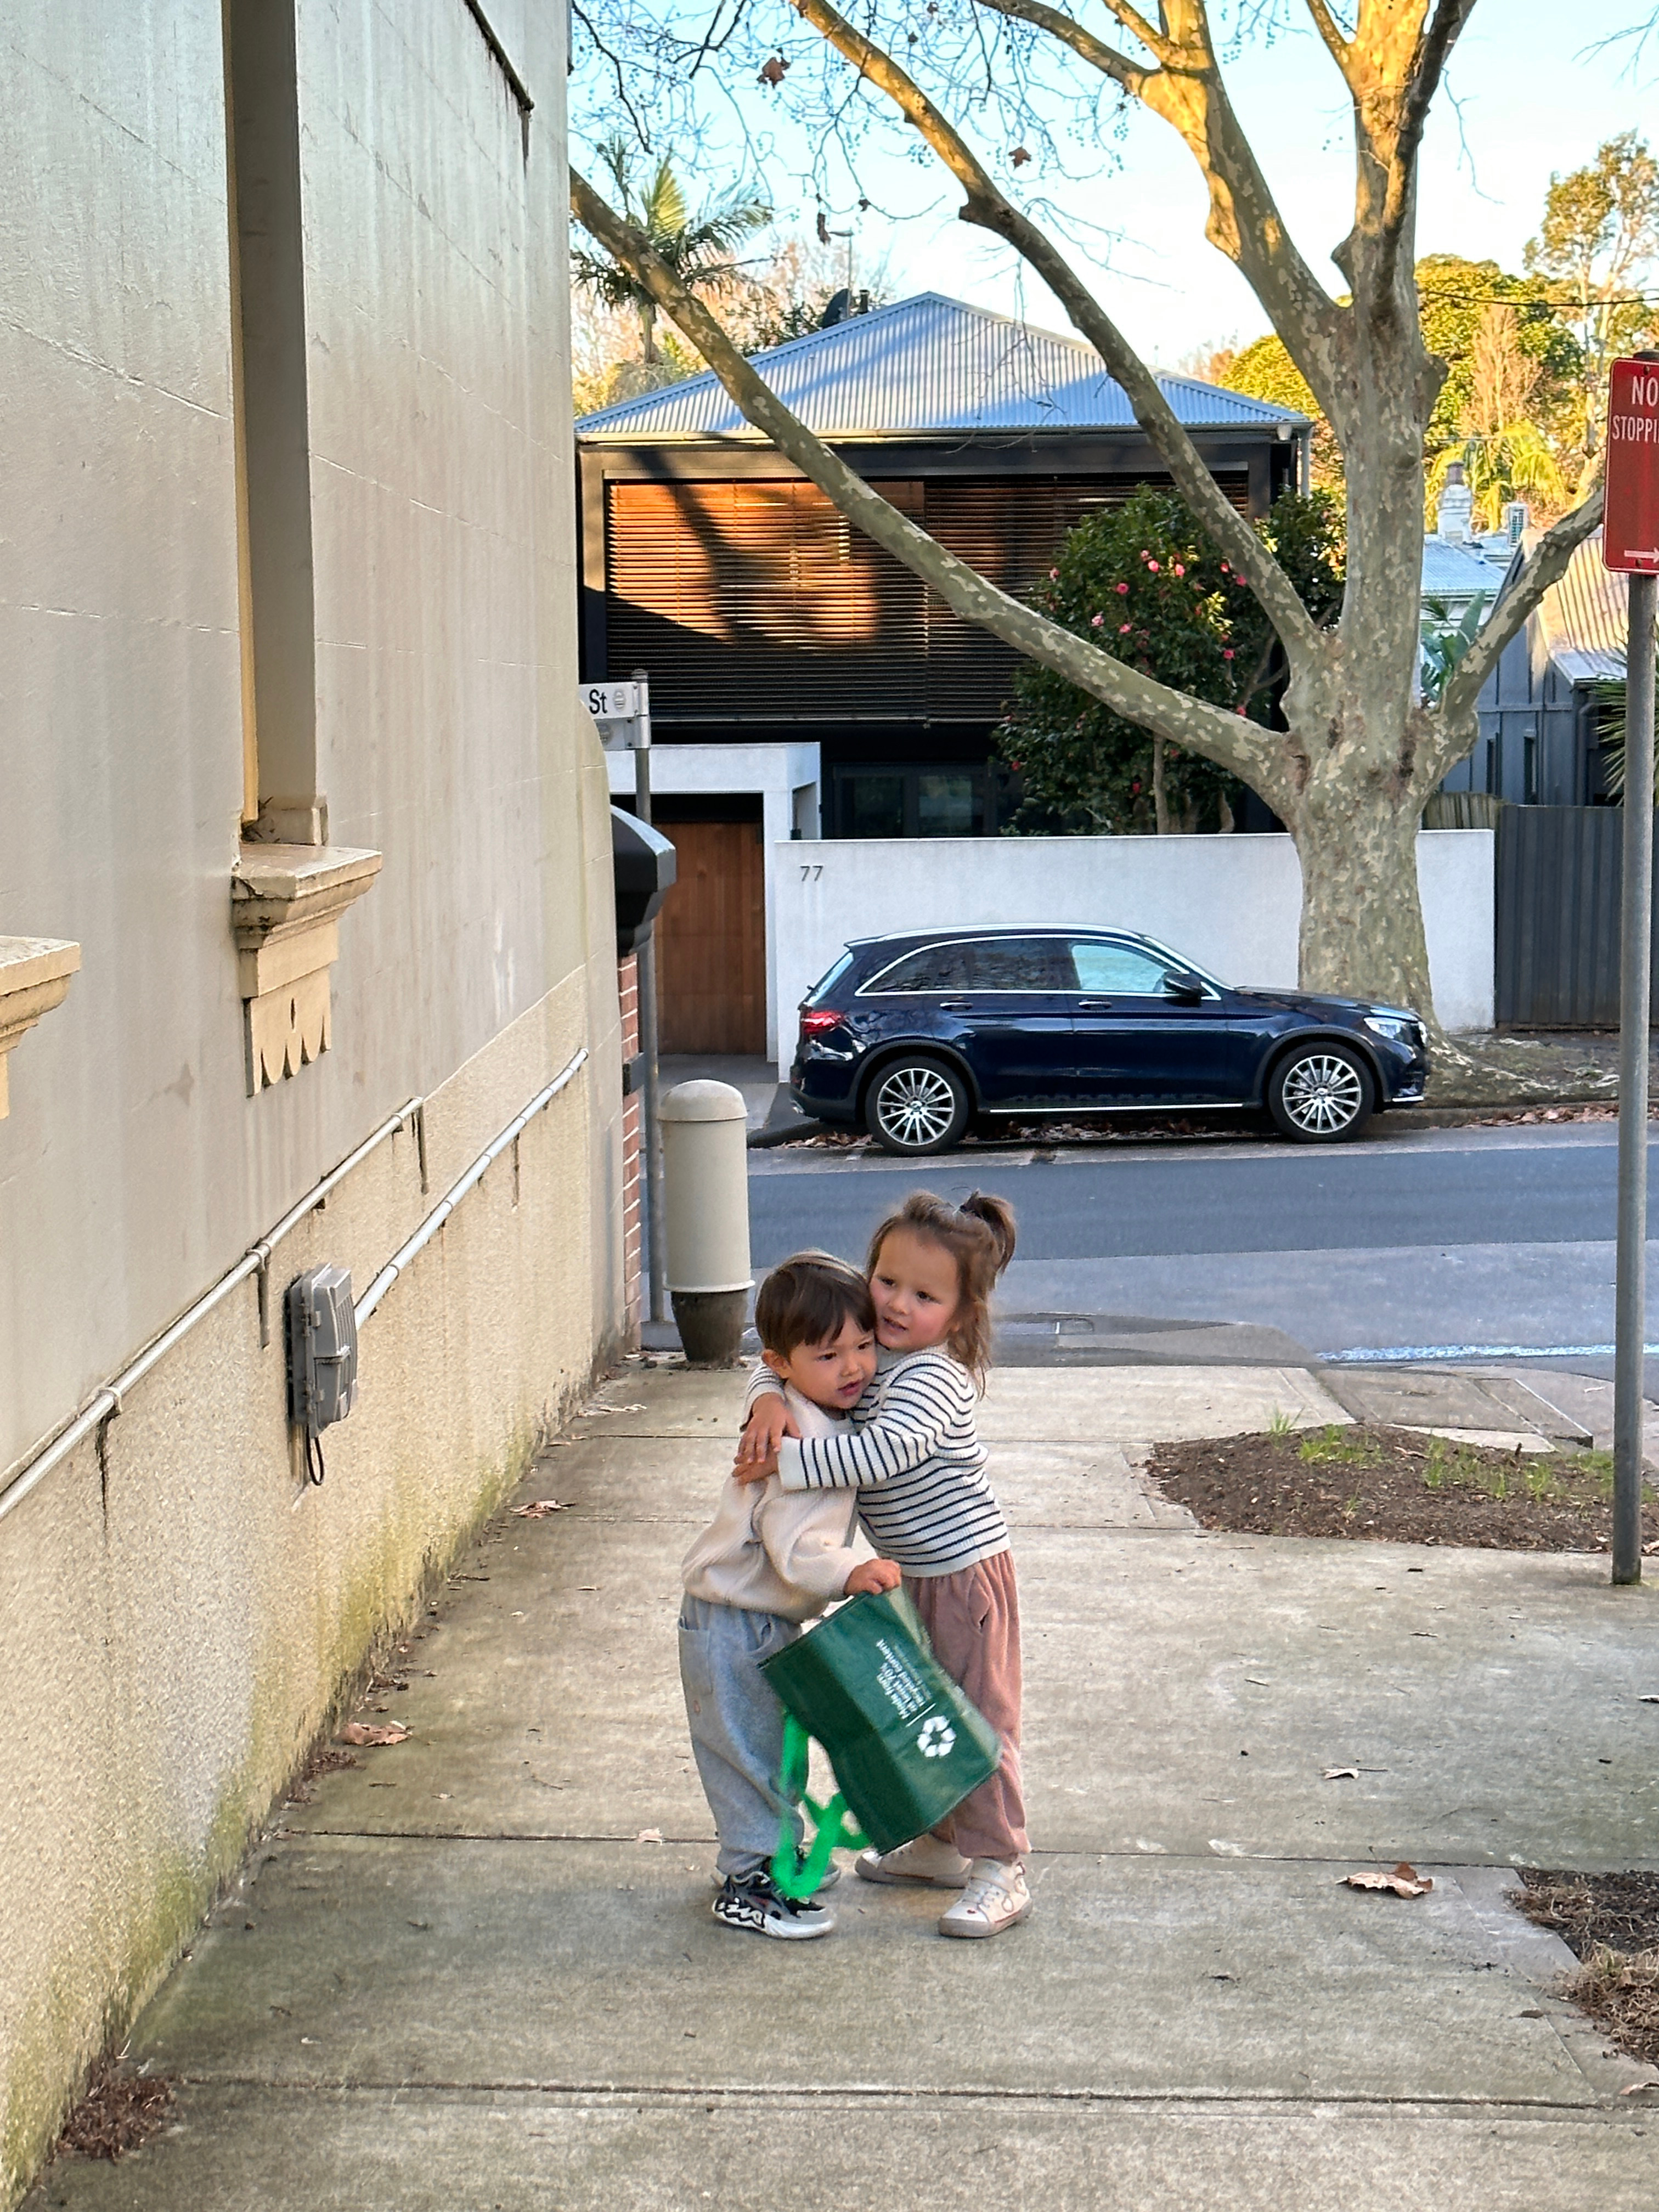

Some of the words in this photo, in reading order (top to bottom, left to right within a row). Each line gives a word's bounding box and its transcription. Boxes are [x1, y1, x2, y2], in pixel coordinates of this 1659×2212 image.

[1632, 376, 1658, 407] NO
[1612, 415, 1659, 443] STOPPI
[589, 689, 608, 714] St
[800, 865, 823, 882] 77
